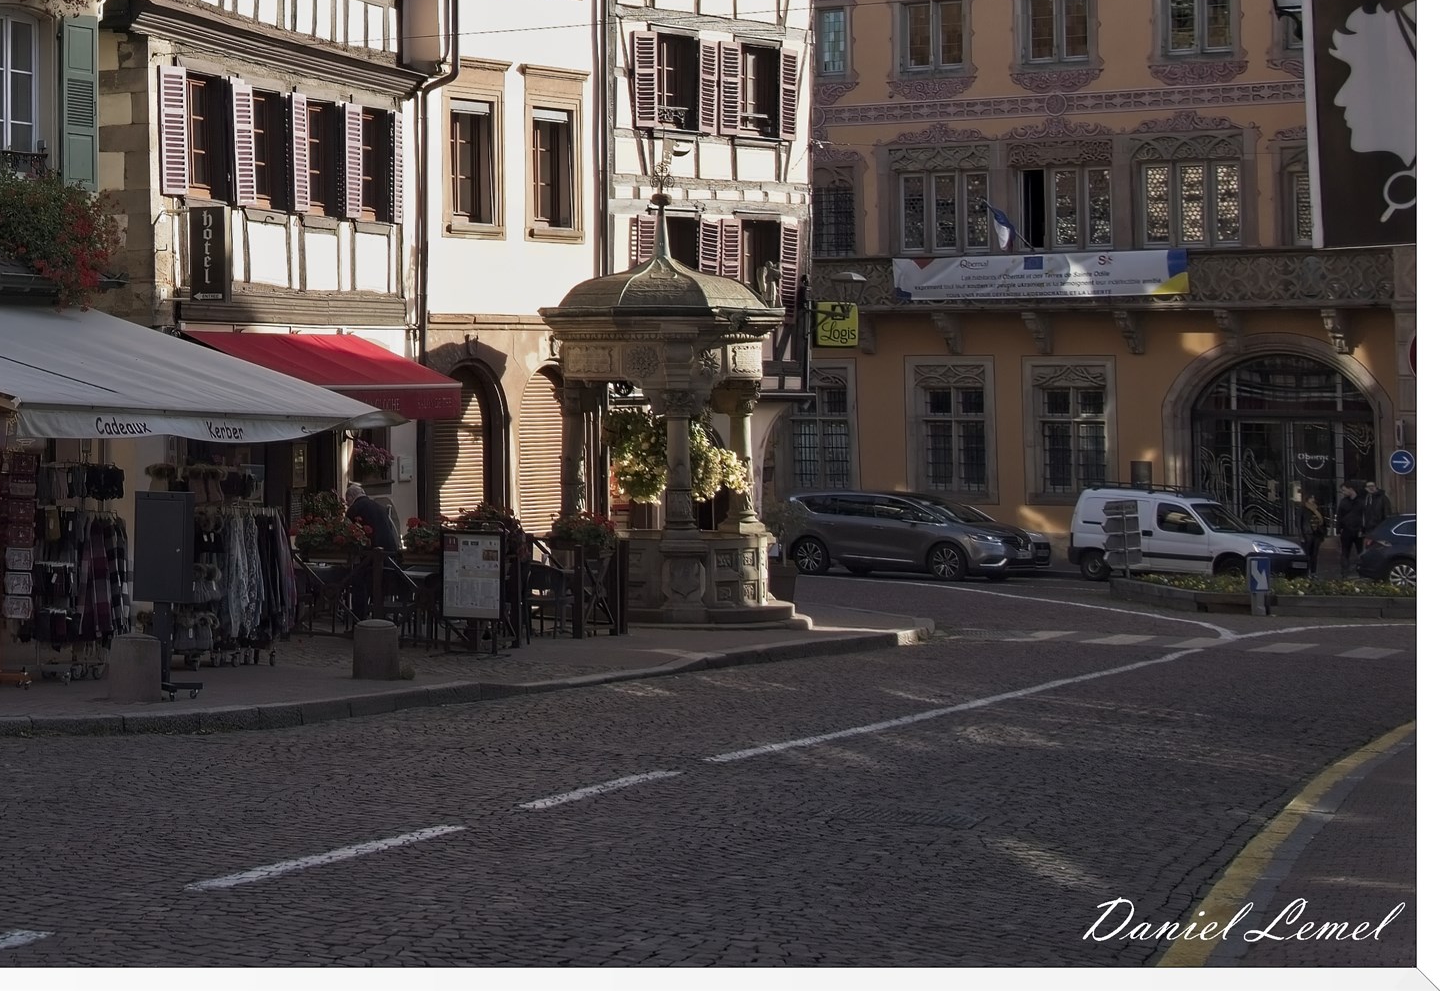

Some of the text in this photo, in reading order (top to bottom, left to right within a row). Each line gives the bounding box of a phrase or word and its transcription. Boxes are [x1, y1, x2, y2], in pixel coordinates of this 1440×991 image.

[820, 321, 856, 344] Logis
[95, 416, 243, 440] Cadeaux Kerber
